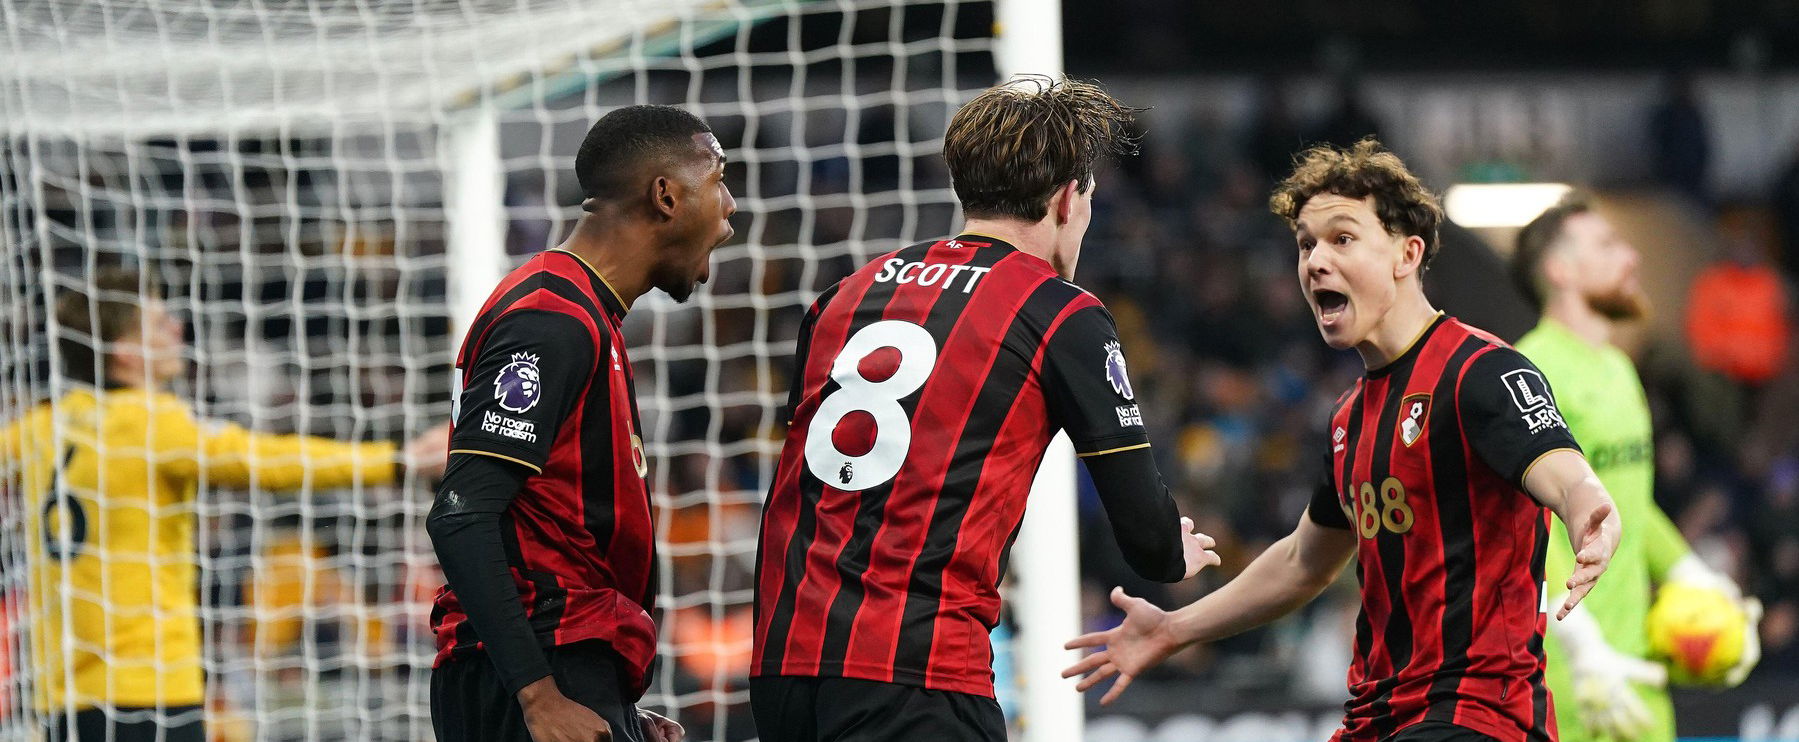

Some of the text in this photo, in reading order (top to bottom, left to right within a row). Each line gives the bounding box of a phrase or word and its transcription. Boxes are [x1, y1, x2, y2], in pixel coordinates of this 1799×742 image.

[875, 258, 991, 293] SCOTT
[484, 410, 534, 432] No room
[804, 320, 937, 491] 8
[43, 440, 87, 562] 6
